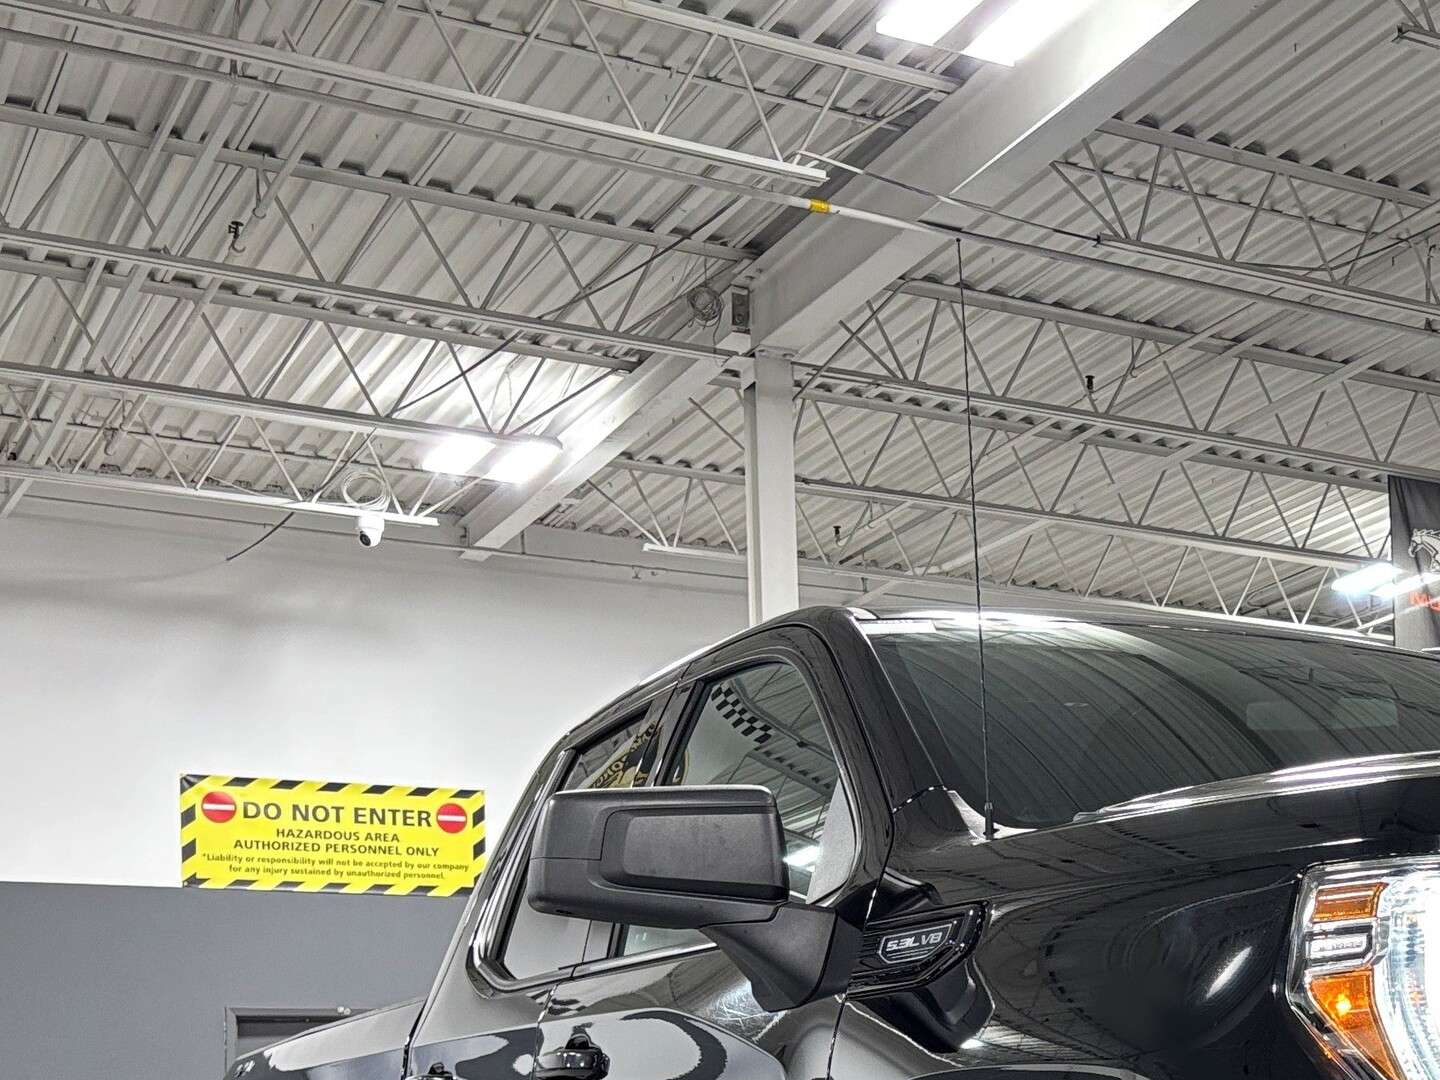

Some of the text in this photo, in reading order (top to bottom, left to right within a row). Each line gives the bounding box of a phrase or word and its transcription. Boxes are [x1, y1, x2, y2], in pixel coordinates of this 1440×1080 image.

[243, 801, 432, 827] DO NOT ENTER
[276, 828, 400, 842] HAZARDOUS AREA
[233, 840, 439, 857] AUTHORIZED PERSONNEL ONLY
[229, 864, 242, 872] for
[244, 866, 260, 874] any
[263, 866, 288, 875] injury
[334, 869, 343, 877] by
[346, 870, 401, 878] unauthorized
[257, 856, 315, 866] responsibility
[352, 859, 364, 867] be
[365, 860, 402, 869] accepted
[405, 861, 414, 869] by
[433, 864, 469, 872] company
[921, 932, 942, 945] V8
